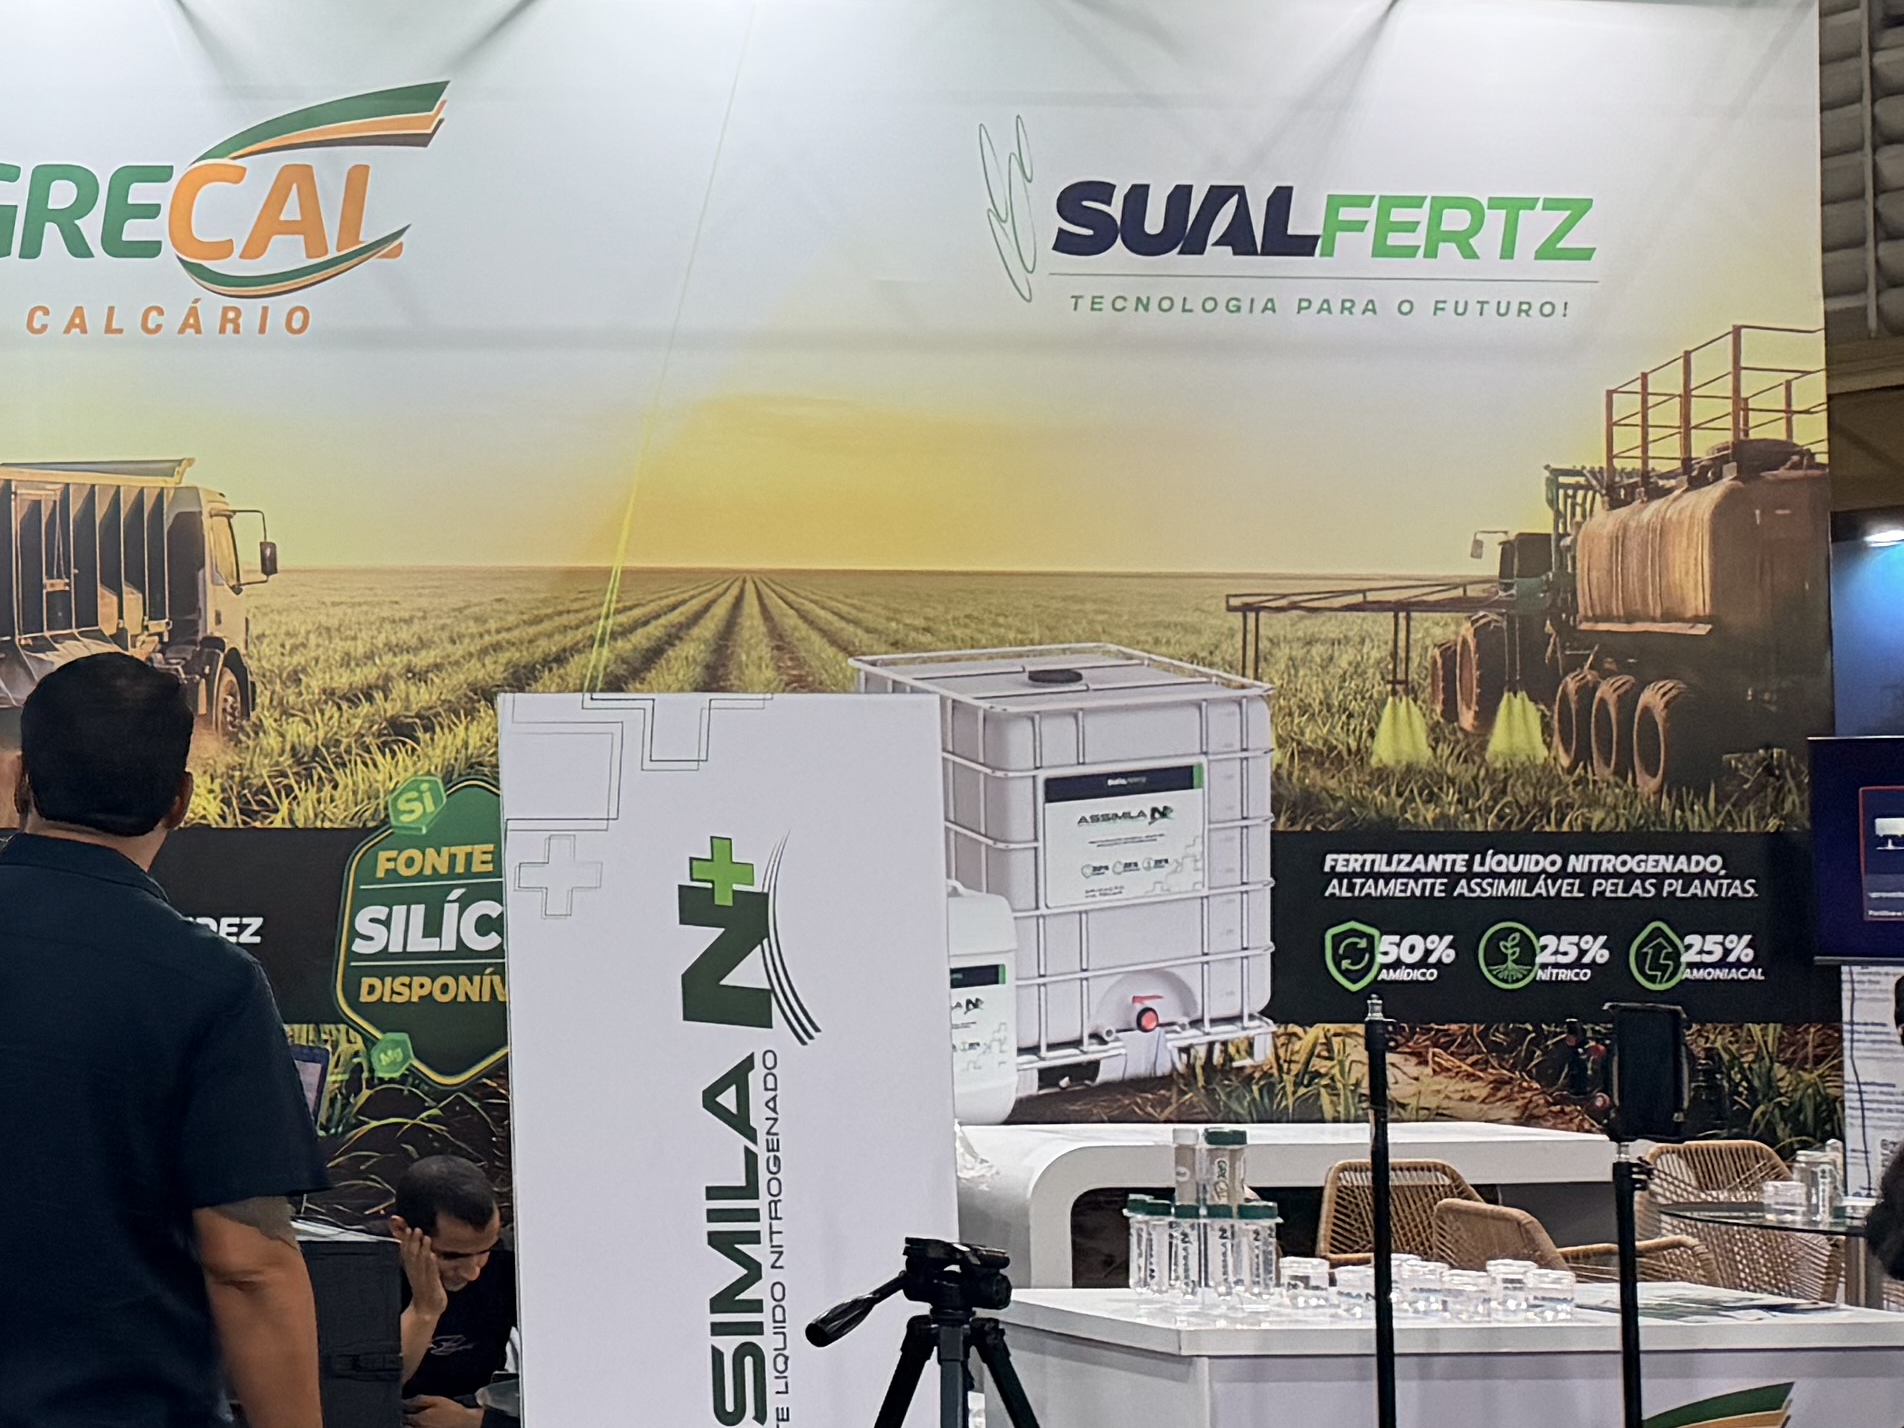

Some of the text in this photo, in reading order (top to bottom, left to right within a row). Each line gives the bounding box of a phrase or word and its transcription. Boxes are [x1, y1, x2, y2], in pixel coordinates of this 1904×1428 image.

[1051, 180, 1597, 261] SUALFERTZ
[26, 298, 312, 336] CALCÁRIO
[1070, 294, 1571, 318] TECNOLOGIA PARA O FUTURO!
[395, 783, 435, 824] Si
[375, 844, 495, 878] FONTE
[1323, 849, 1726, 876] FERTILIZANTE LÍQUIDO NITROGENADO,
[1324, 875, 1759, 899] ALTAMENTE ASSIMILÁVEL PELAS PLANTAS.
[351, 888, 505, 954] SILÍC
[1377, 934, 1456, 965] 50%
[1535, 934, 1610, 965] 25%
[1680, 934, 1755, 964] 25%
[1377, 966, 1439, 982] AMÍDICO
[1536, 966, 1592, 982] NÍTRICO
[1682, 968, 1765, 982] AMONIACAL
[380, 1047, 404, 1066] Mg
[762, 1049, 786, 1271] NITROGENADO
[770, 1279, 790, 1402] LIQUIDO
